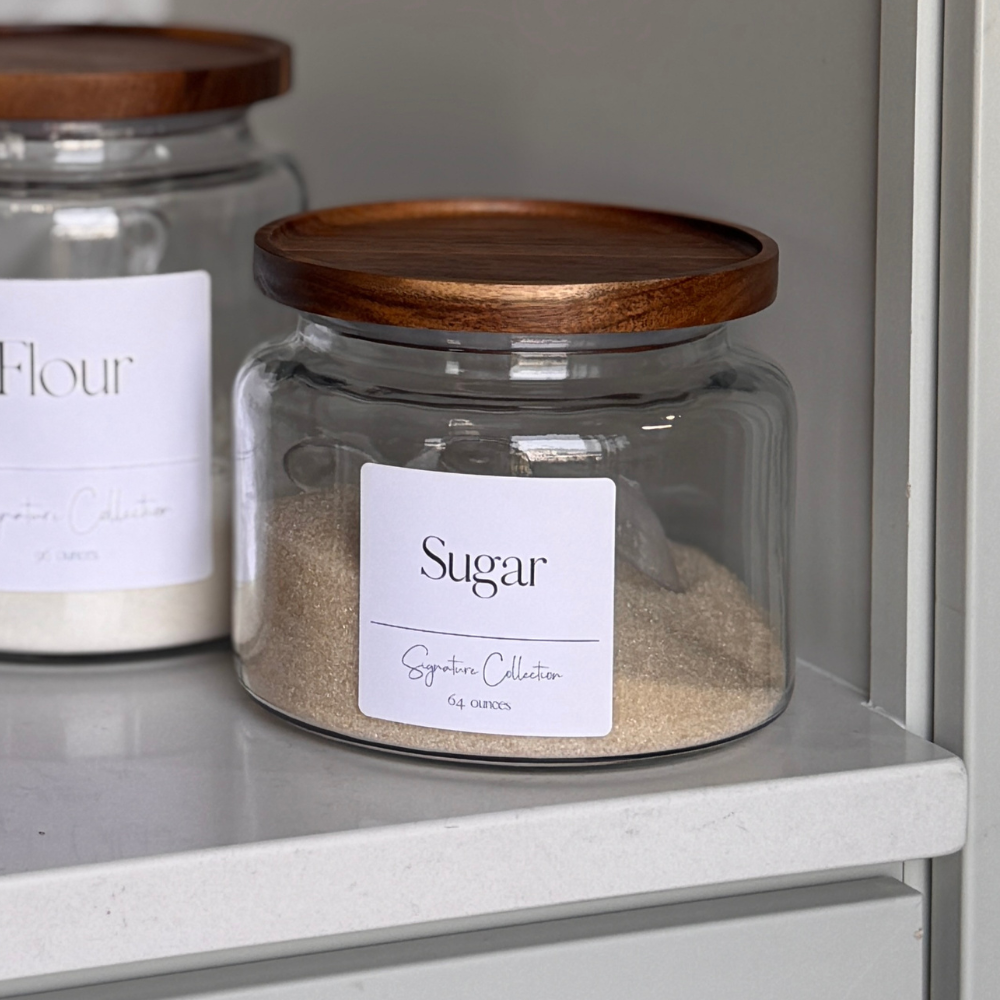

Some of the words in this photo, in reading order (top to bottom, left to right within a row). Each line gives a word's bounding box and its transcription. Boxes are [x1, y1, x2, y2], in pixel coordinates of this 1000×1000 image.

[420, 535, 548, 599] Sugar
[401, 644, 479, 687] Signature
[482, 652, 563, 687] Collection
[447, 693, 466, 711] 64
[470, 698, 512, 711] ounces
